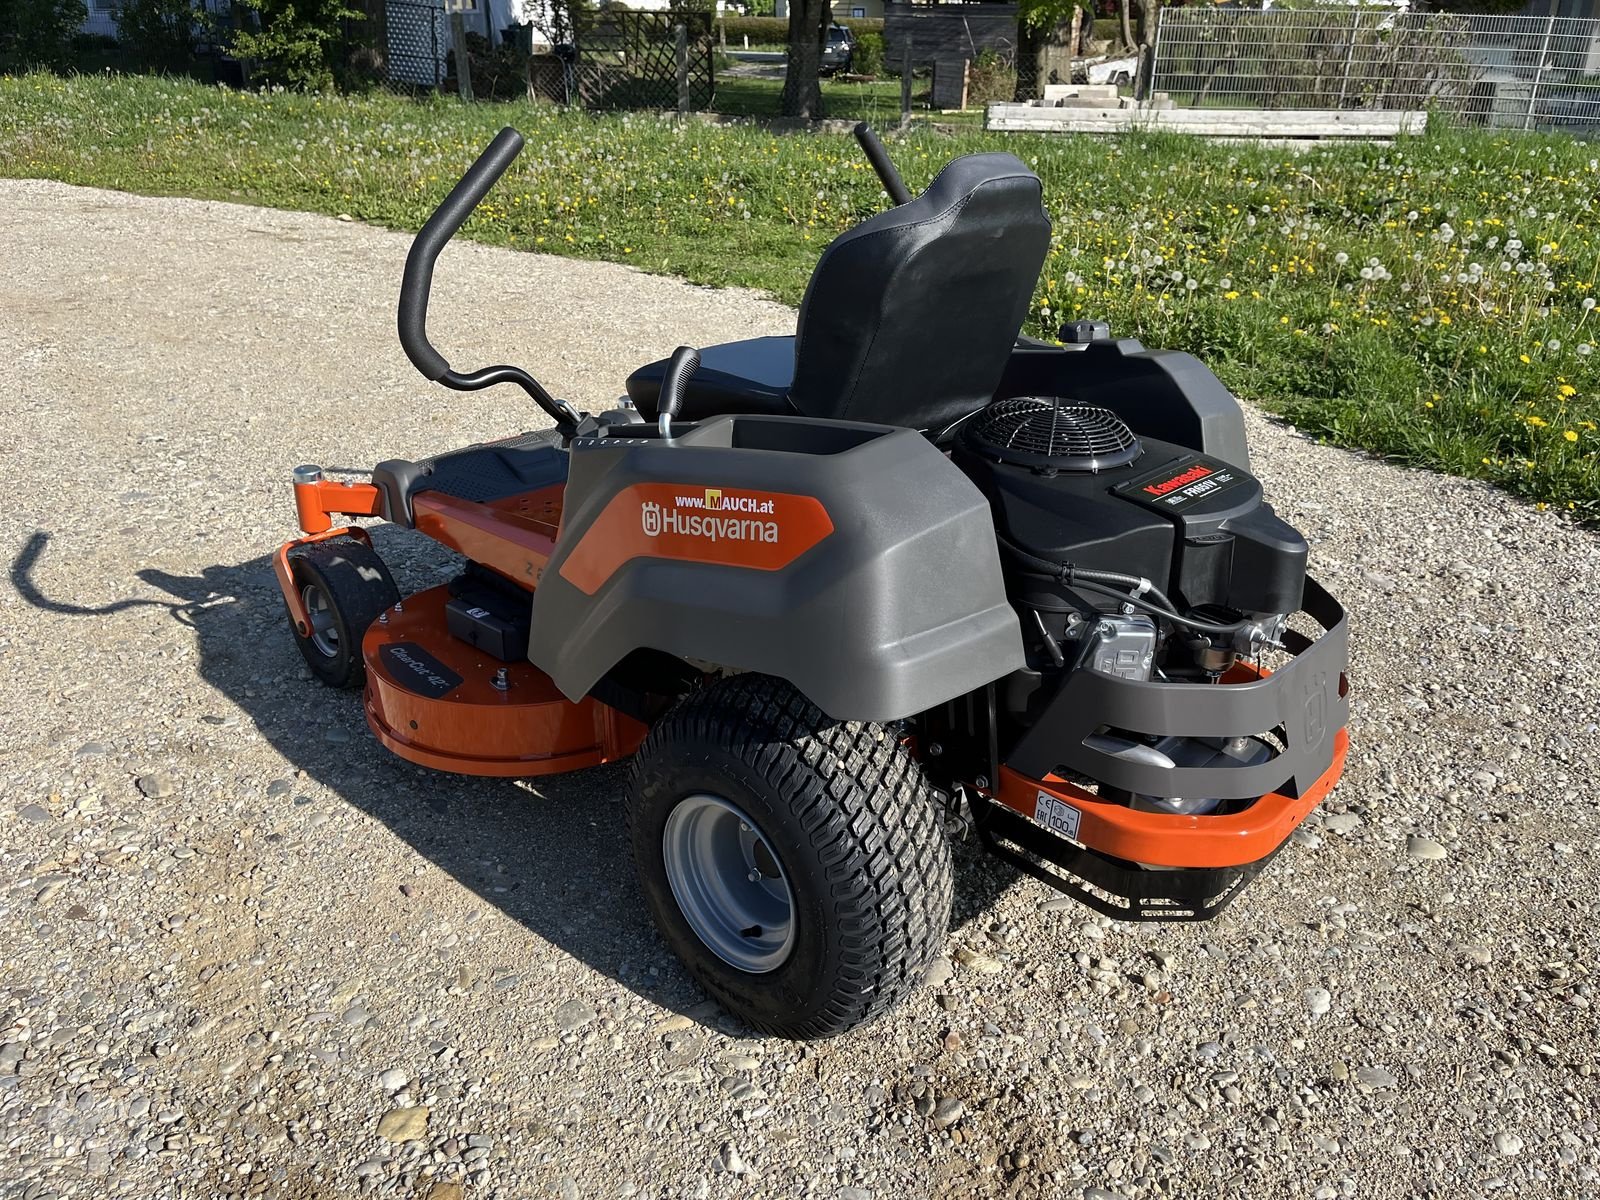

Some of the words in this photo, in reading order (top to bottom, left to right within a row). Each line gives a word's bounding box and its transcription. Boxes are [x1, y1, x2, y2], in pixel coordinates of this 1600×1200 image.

[1143, 466, 1214, 495] Kawasaki
[675, 489, 774, 514] www.MAUCH.at
[663, 508, 778, 543] Husqvarna
[1051, 815, 1069, 833] 100
